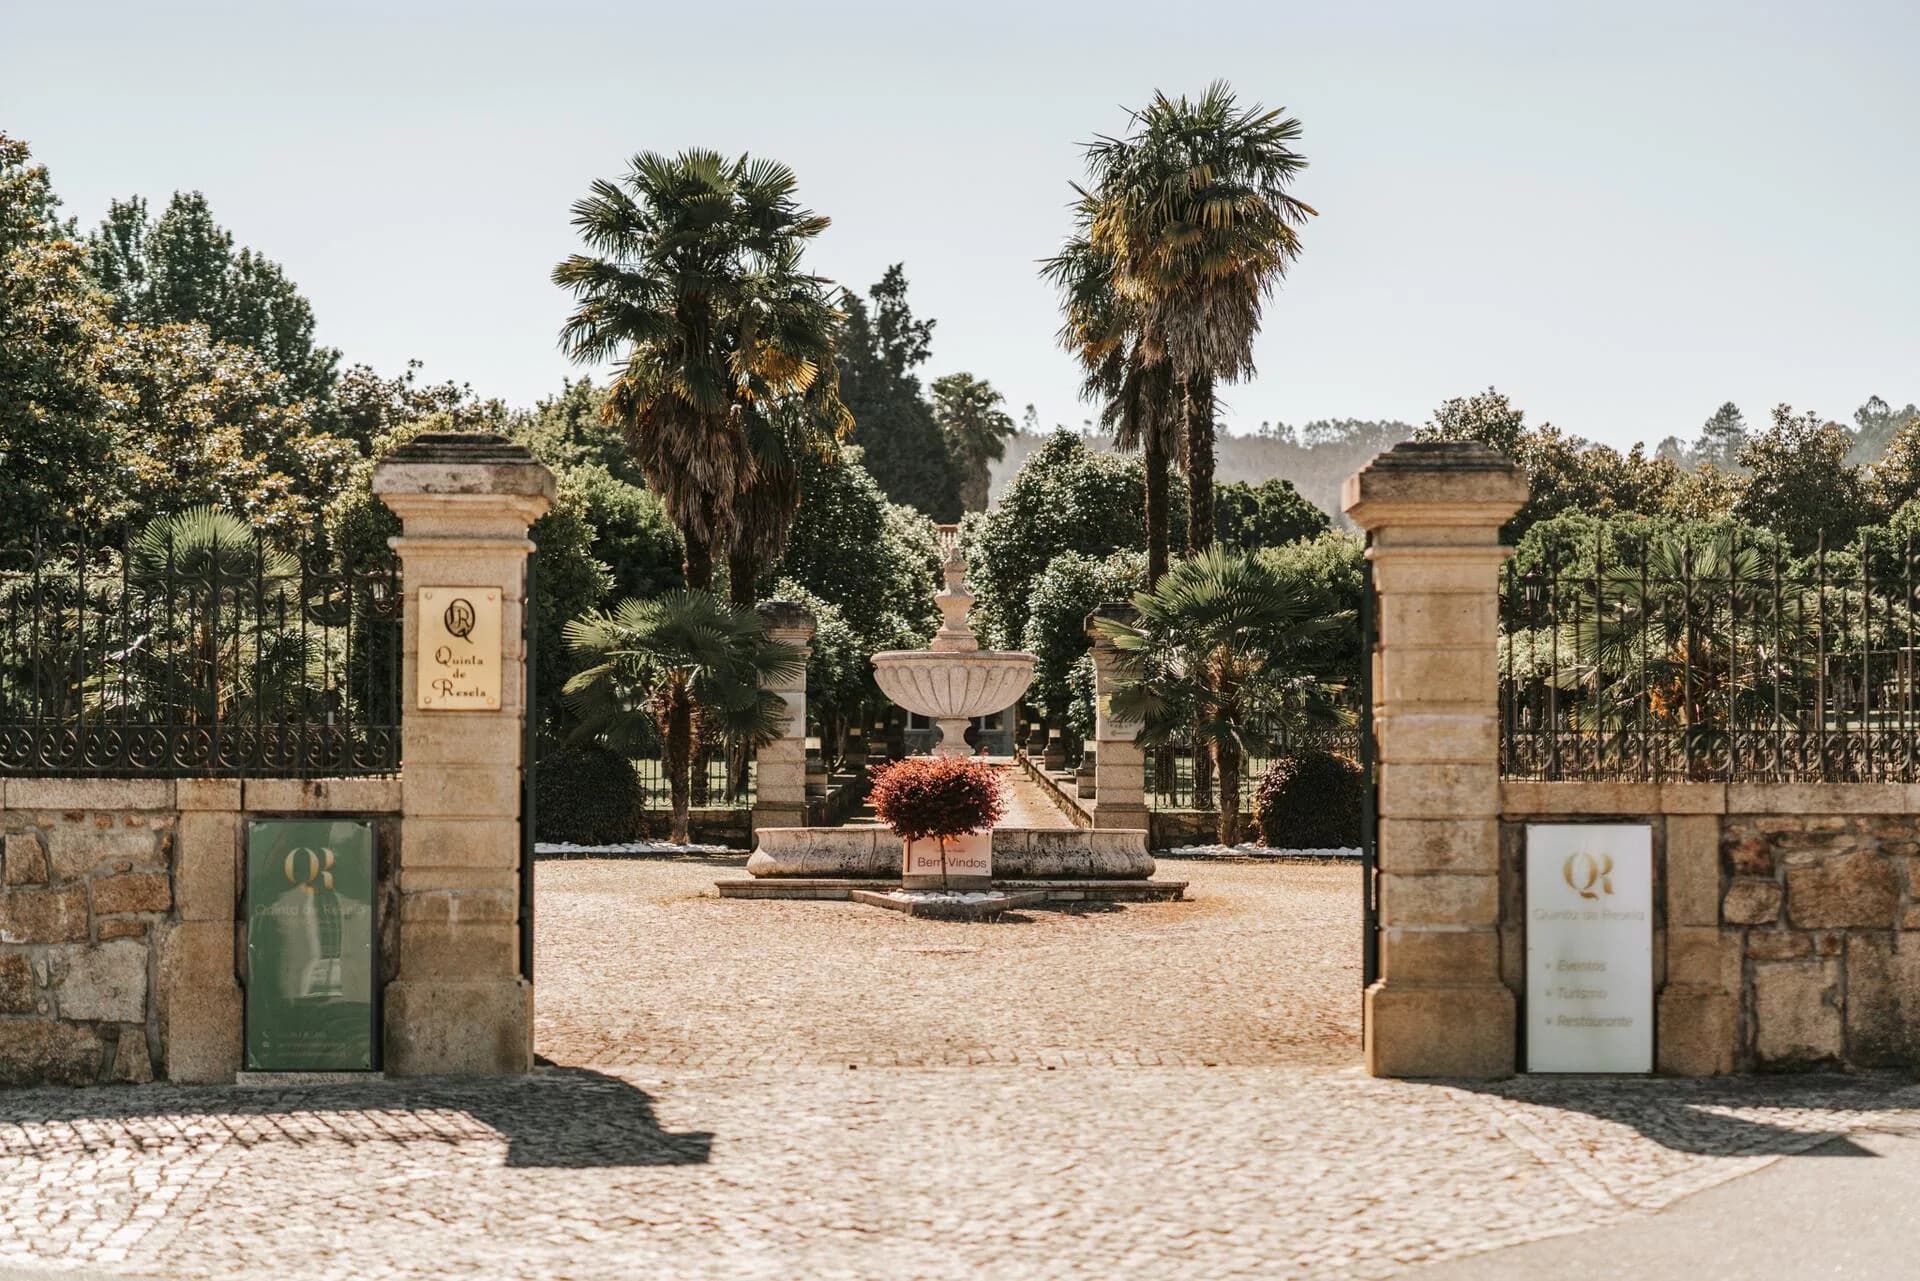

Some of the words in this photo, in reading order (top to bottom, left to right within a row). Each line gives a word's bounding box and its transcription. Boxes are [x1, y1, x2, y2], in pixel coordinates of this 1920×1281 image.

[435, 646, 483, 667] Quinta
[452, 668, 466, 678] de
[284, 847, 336, 896] QR
[1562, 850, 1614, 901] QR
[1557, 959, 1607, 972] Eventos
[1558, 986, 1608, 999] Turismo
[1557, 1014, 1633, 1028] Restaurante
